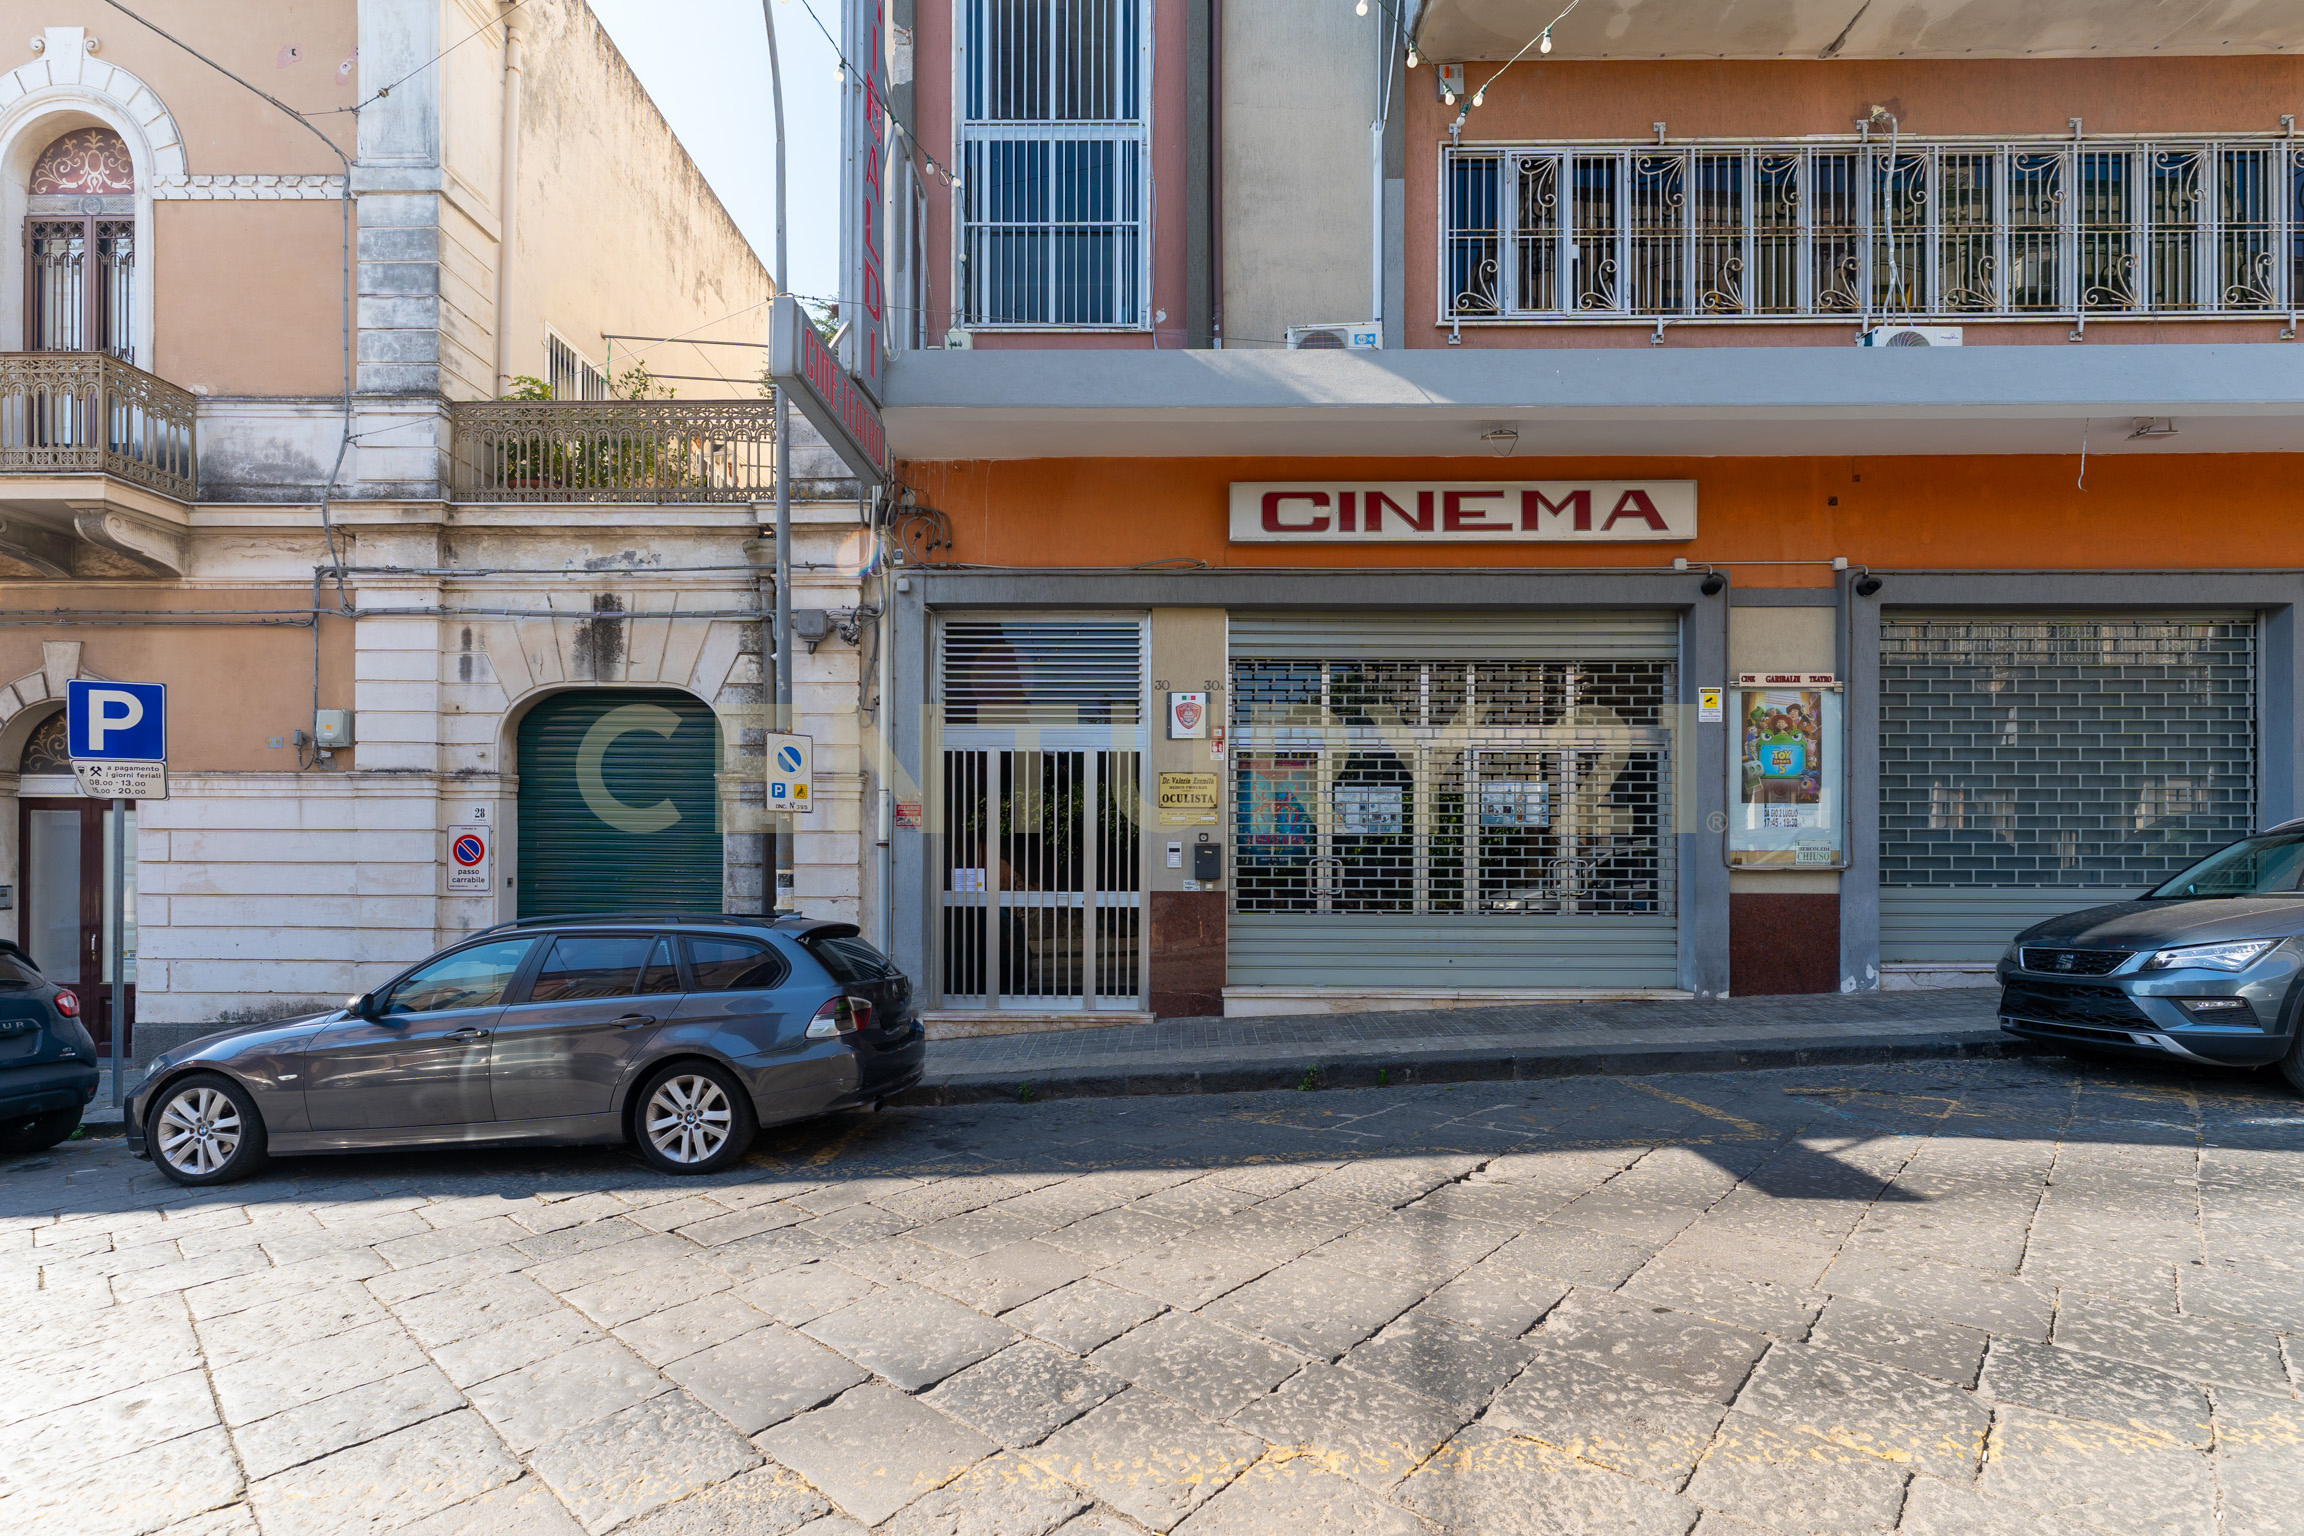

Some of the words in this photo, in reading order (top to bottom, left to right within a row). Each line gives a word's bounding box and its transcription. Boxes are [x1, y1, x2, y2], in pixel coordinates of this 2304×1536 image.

[865, 0, 882, 380] IBALDI
[805, 326, 882, 468] CINE-TEATRO
[1261, 489, 1669, 533] CINEMA
[1741, 675, 1756, 683] CINE
[1765, 675, 1801, 683] GARIBALDI
[1809, 675, 1833, 683] TEATRO
[1154, 680, 1171, 691] 30
[88, 689, 144, 751] P
[1771, 750, 1792, 760] TOY
[1778, 763, 1787, 774] 5
[1162, 777, 1171, 785] Dr.
[774, 785, 783, 797] P
[1161, 793, 1215, 804] OCULISTA
[474, 807, 486, 819] 28
[1770, 809, 1779, 817] GIO
[1782, 809, 1798, 817] LUGLIO
[1764, 818, 1779, 827] 17:45
[1797, 852, 1830, 861] CHIUSO
